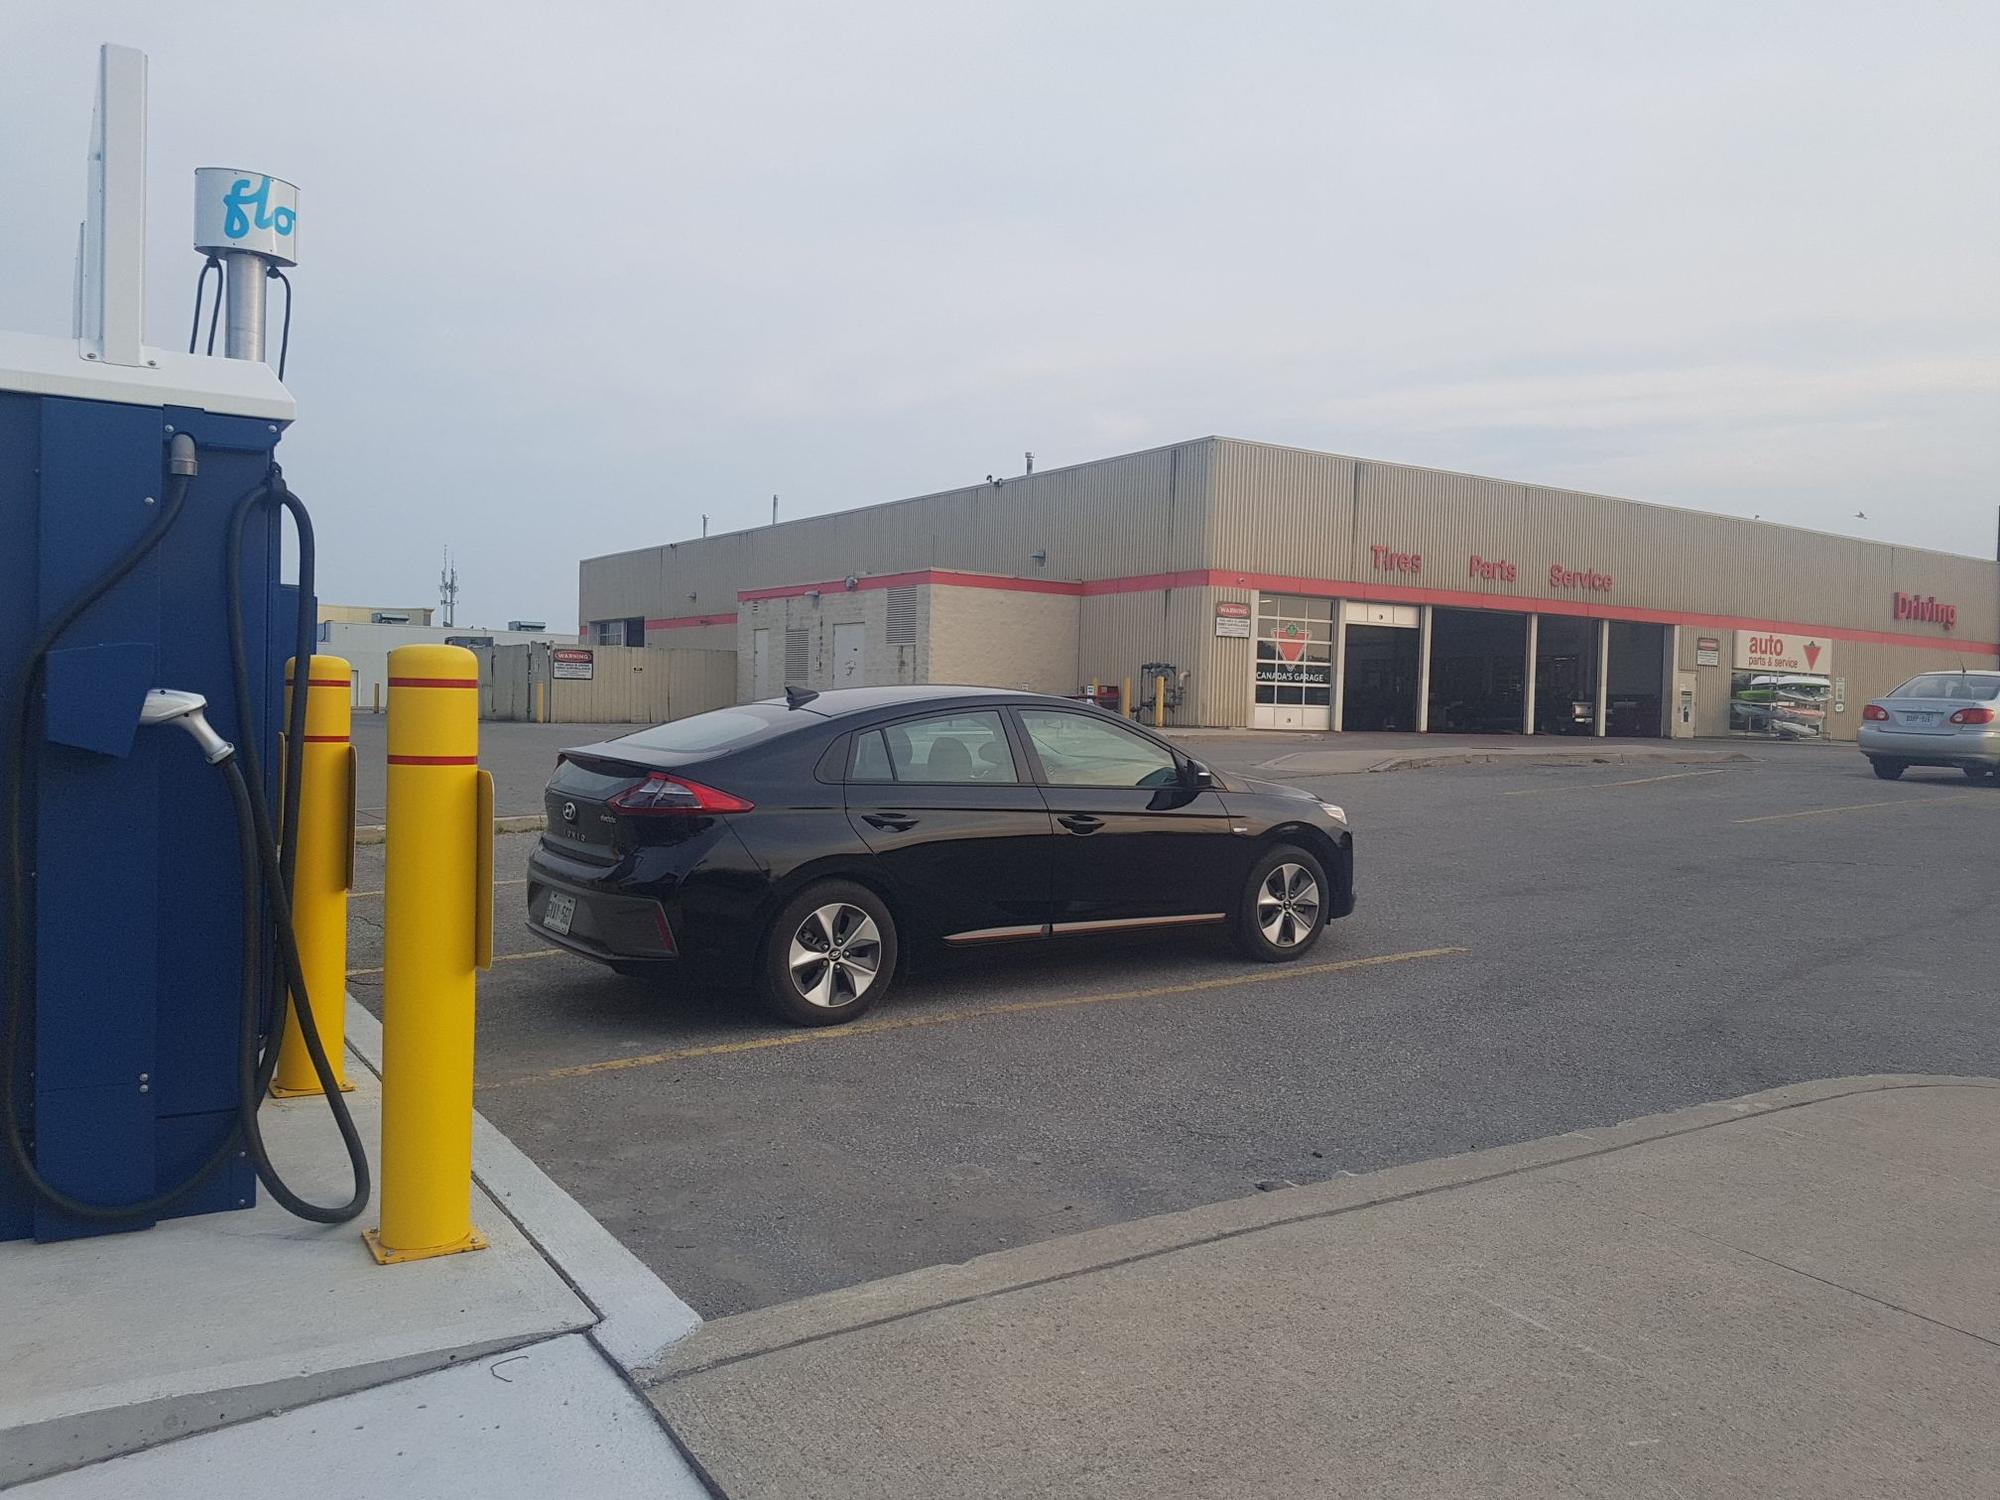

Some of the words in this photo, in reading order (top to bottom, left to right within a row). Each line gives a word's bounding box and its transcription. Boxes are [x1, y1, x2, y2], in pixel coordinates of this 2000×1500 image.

[222, 175, 296, 239] flo
[1371, 544, 1422, 574] Tires
[1469, 554, 1518, 582] Parts
[1550, 563, 1615, 592] Service
[1219, 607, 1249, 615] WARNING
[1893, 591, 1957, 630] Driving
[1749, 635, 1784, 656] auto
[558, 652, 589, 660] WARNING
[1748, 656, 1766, 667] parts
[1767, 656, 1773, 666] &
[1774, 657, 1799, 668] service
[1256, 671, 1293, 681] CANADA'S
[1293, 672, 1324, 682] GARAGE
